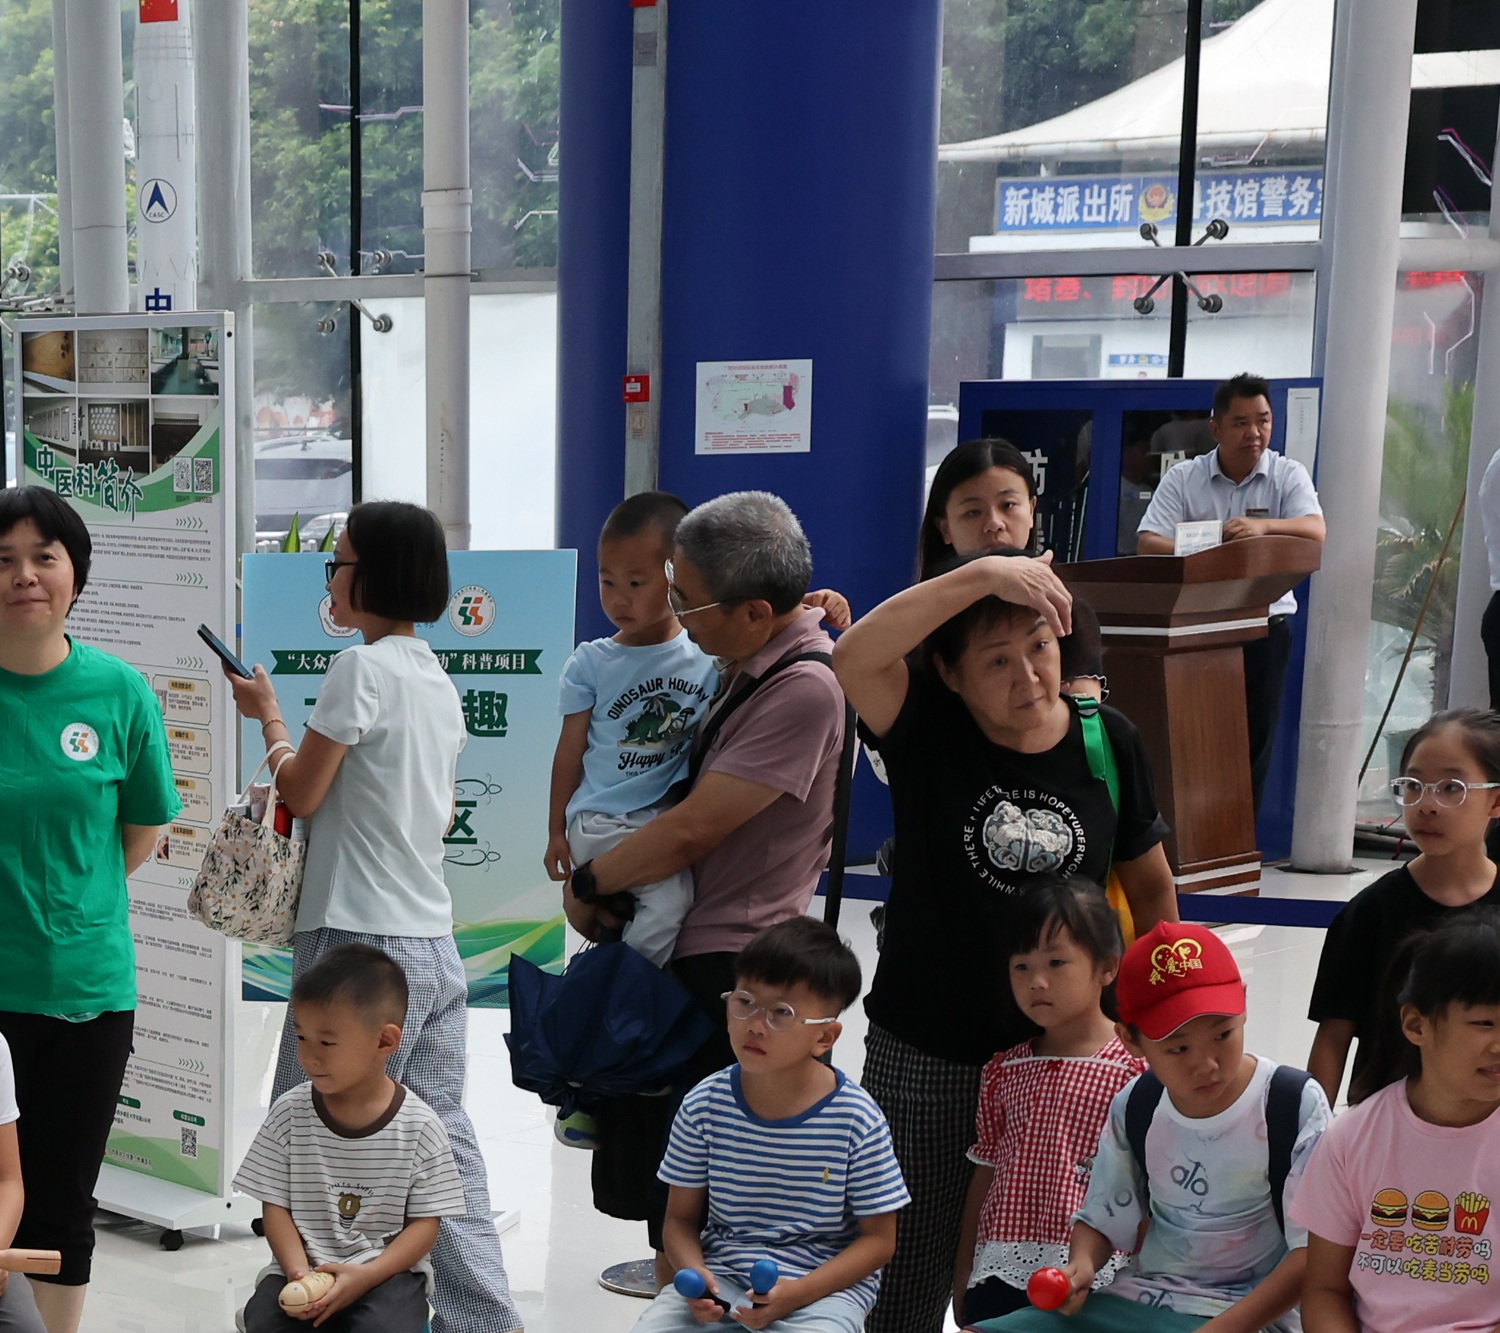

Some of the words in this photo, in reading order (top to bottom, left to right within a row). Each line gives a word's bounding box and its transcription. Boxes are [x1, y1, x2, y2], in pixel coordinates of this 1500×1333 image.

[1003, 183, 1133, 226] 新城派出所
[1193, 176, 1323, 220] 技馆警务
[35, 443, 144, 522] 中医科简介
[461, 689, 509, 738] 趣
[607, 677, 664, 721] DINOSAUR
[617, 751, 666, 771] Happy
[1023, 789, 1036, 799] IS
[1170, 1161, 1209, 1197] alo
[1360, 1228, 1493, 1260] 一定要吃苦耐劳吗
[1357, 1251, 1490, 1285] 不可以吃麦当劳吗
